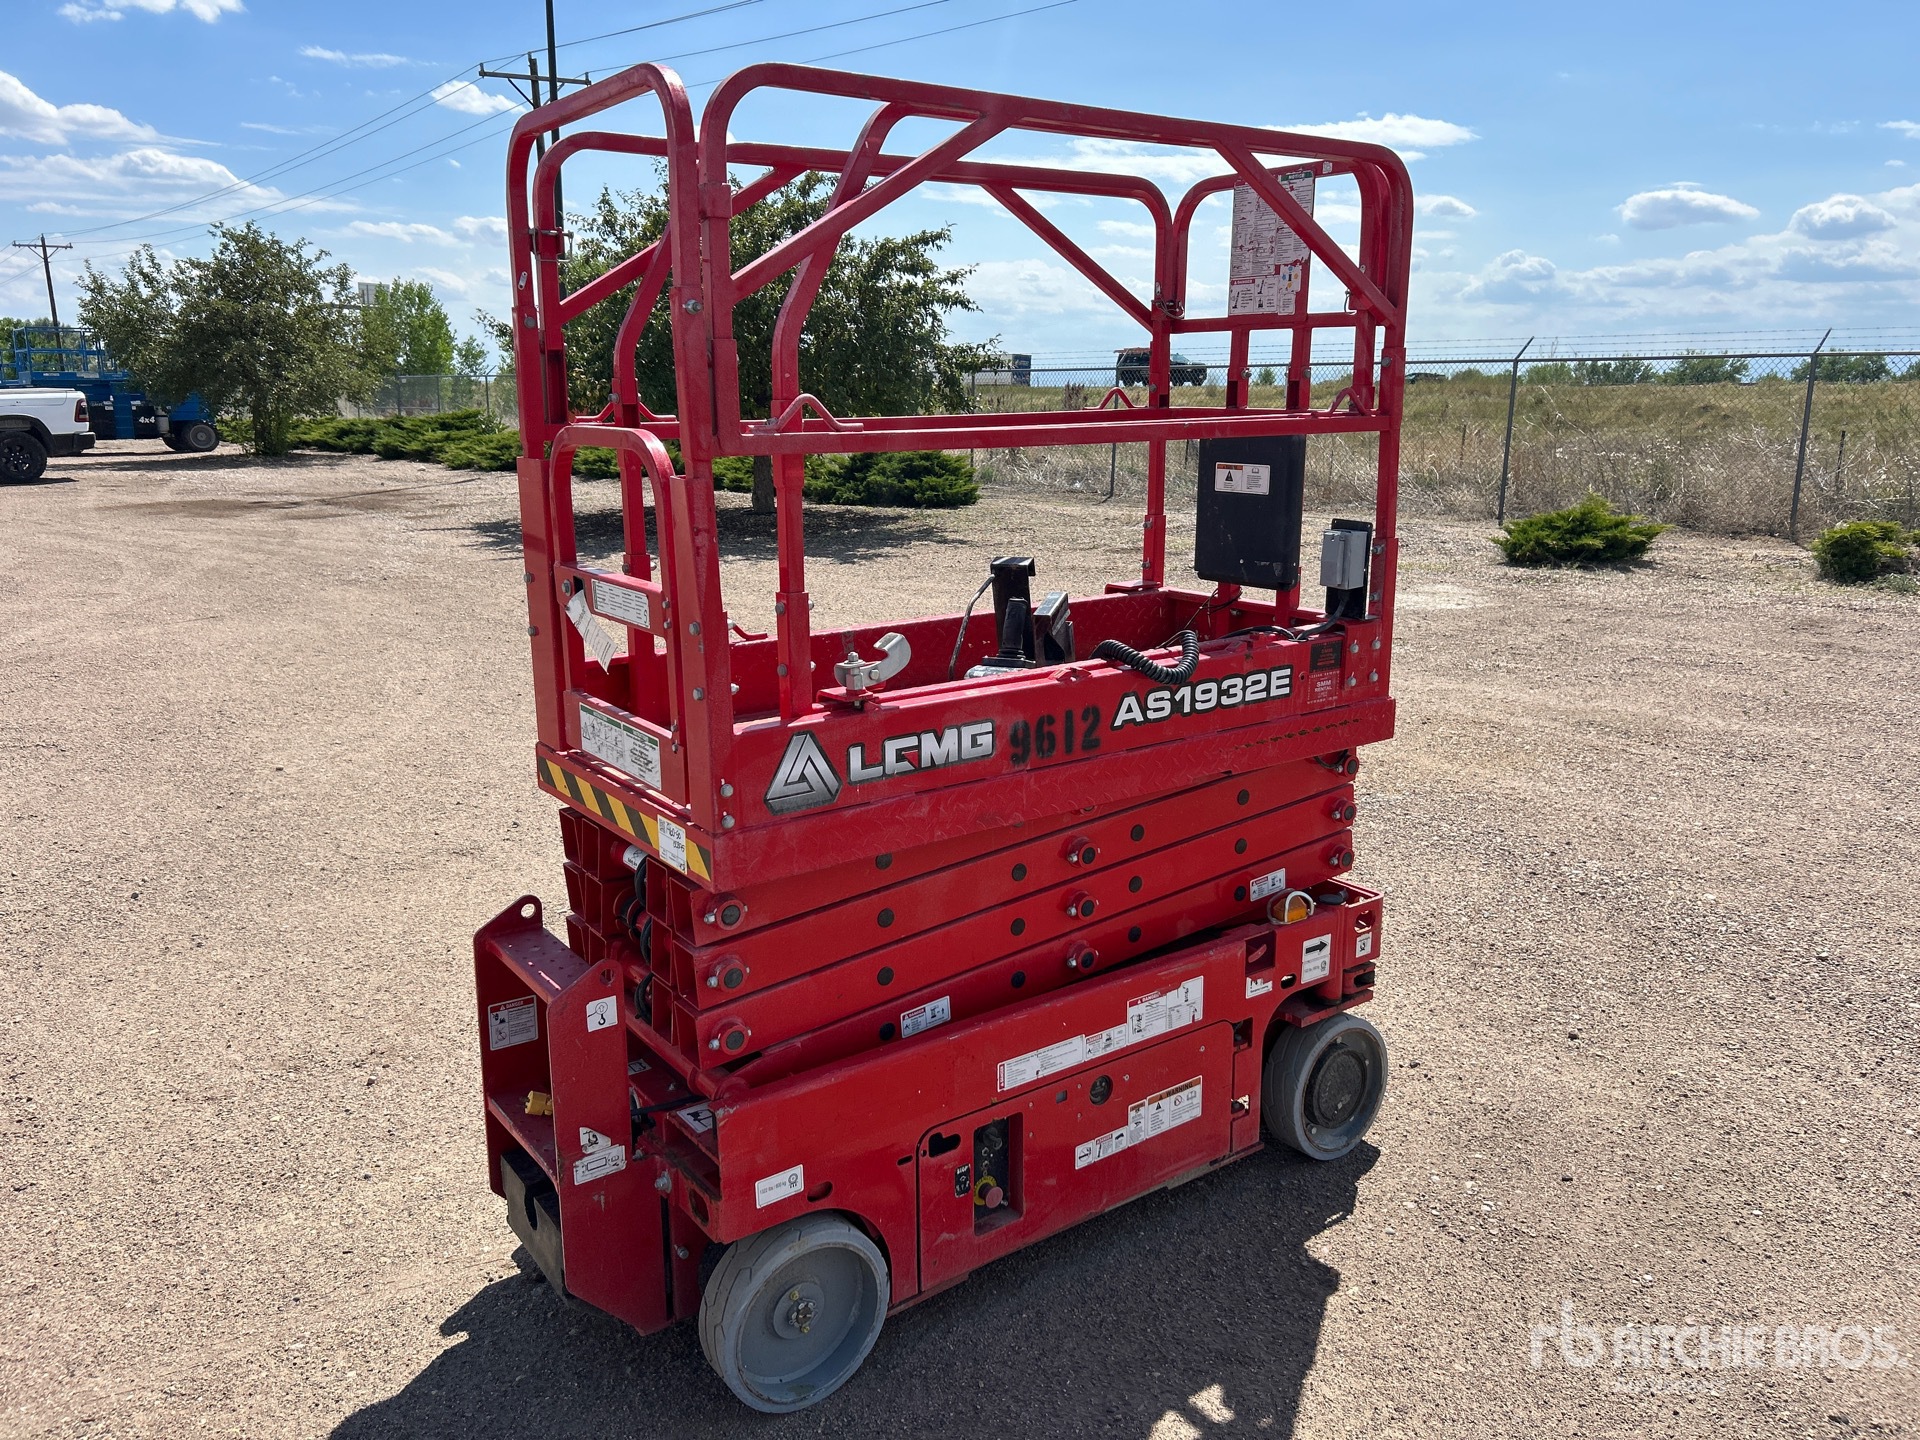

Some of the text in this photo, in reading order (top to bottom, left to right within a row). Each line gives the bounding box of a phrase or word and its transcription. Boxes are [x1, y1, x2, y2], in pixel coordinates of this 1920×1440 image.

[1112, 667, 1292, 728] AS1932E
[1010, 705, 1101, 765] 9612
[1166, 1081, 1193, 1097] WARNING
